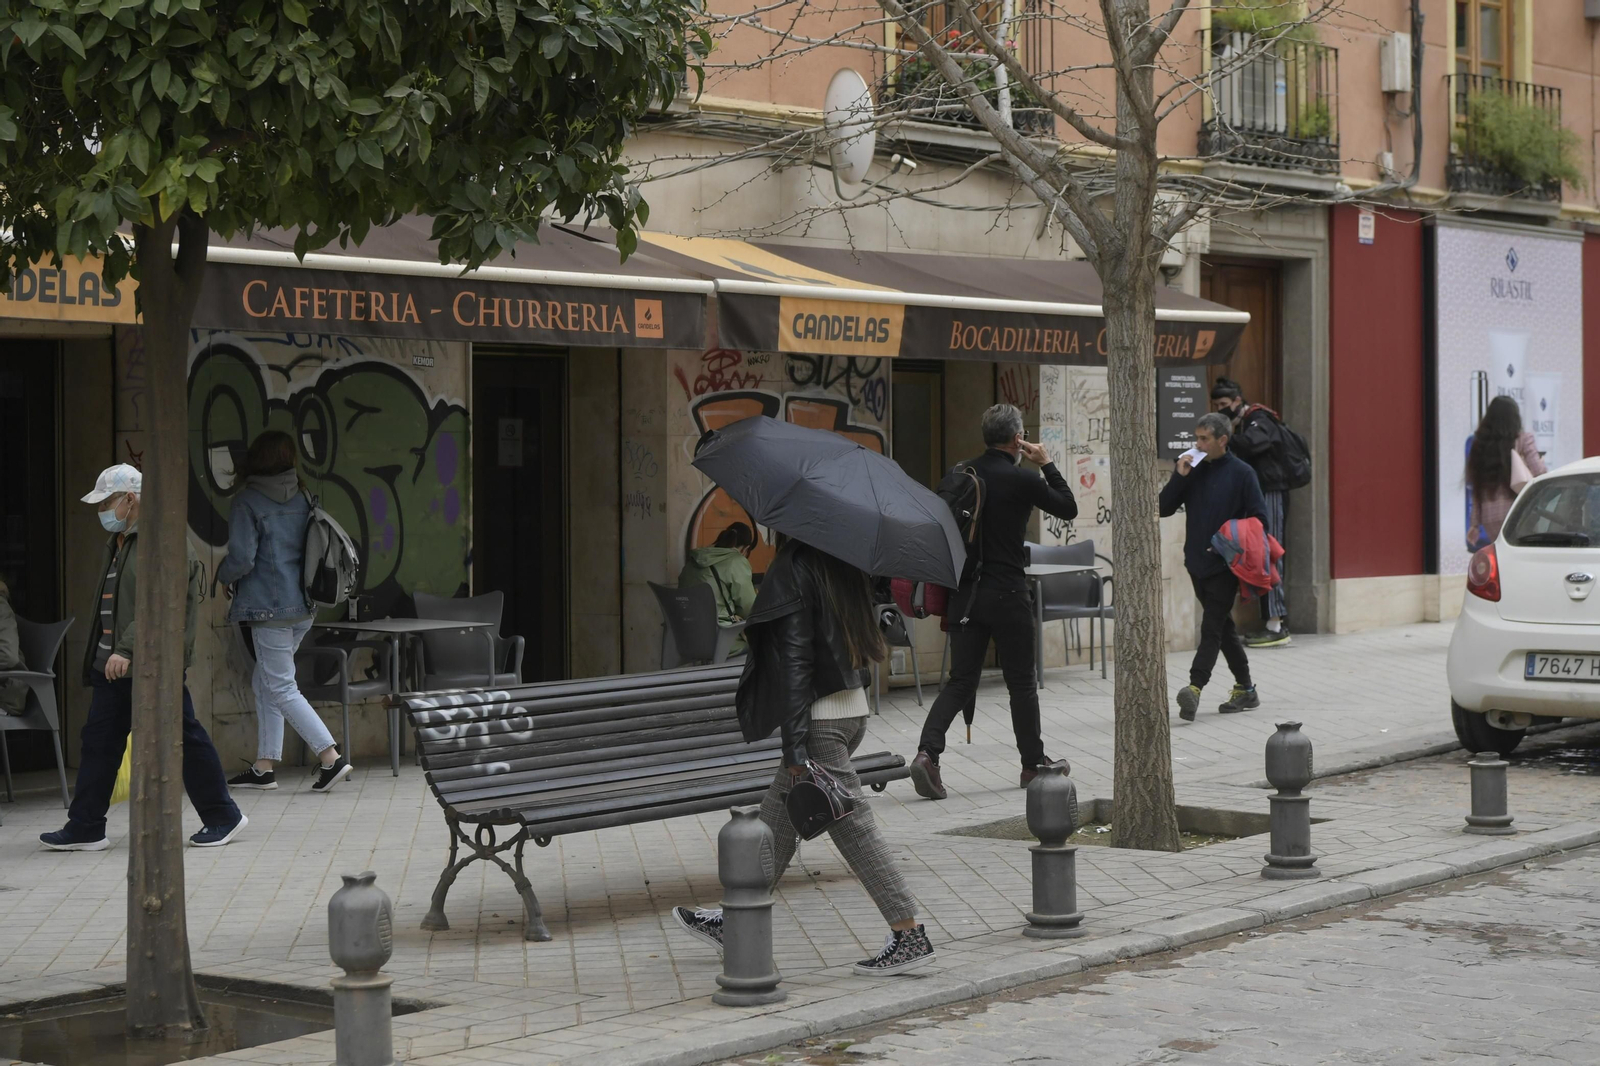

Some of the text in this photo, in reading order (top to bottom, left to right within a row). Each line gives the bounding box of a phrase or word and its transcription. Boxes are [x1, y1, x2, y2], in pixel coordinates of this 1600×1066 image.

[1490, 277, 1533, 300] RILASTIL
[242, 279, 422, 324] CAFETERIA
[452, 291, 630, 334] CHURRERIA
[792, 312, 890, 344] CANDELAS
[949, 320, 1080, 354] BOCADILLERIA
[412, 356, 434, 367] KEMOR
[1569, 573, 1587, 582] Ford
[1538, 657, 1584, 676] 7647
